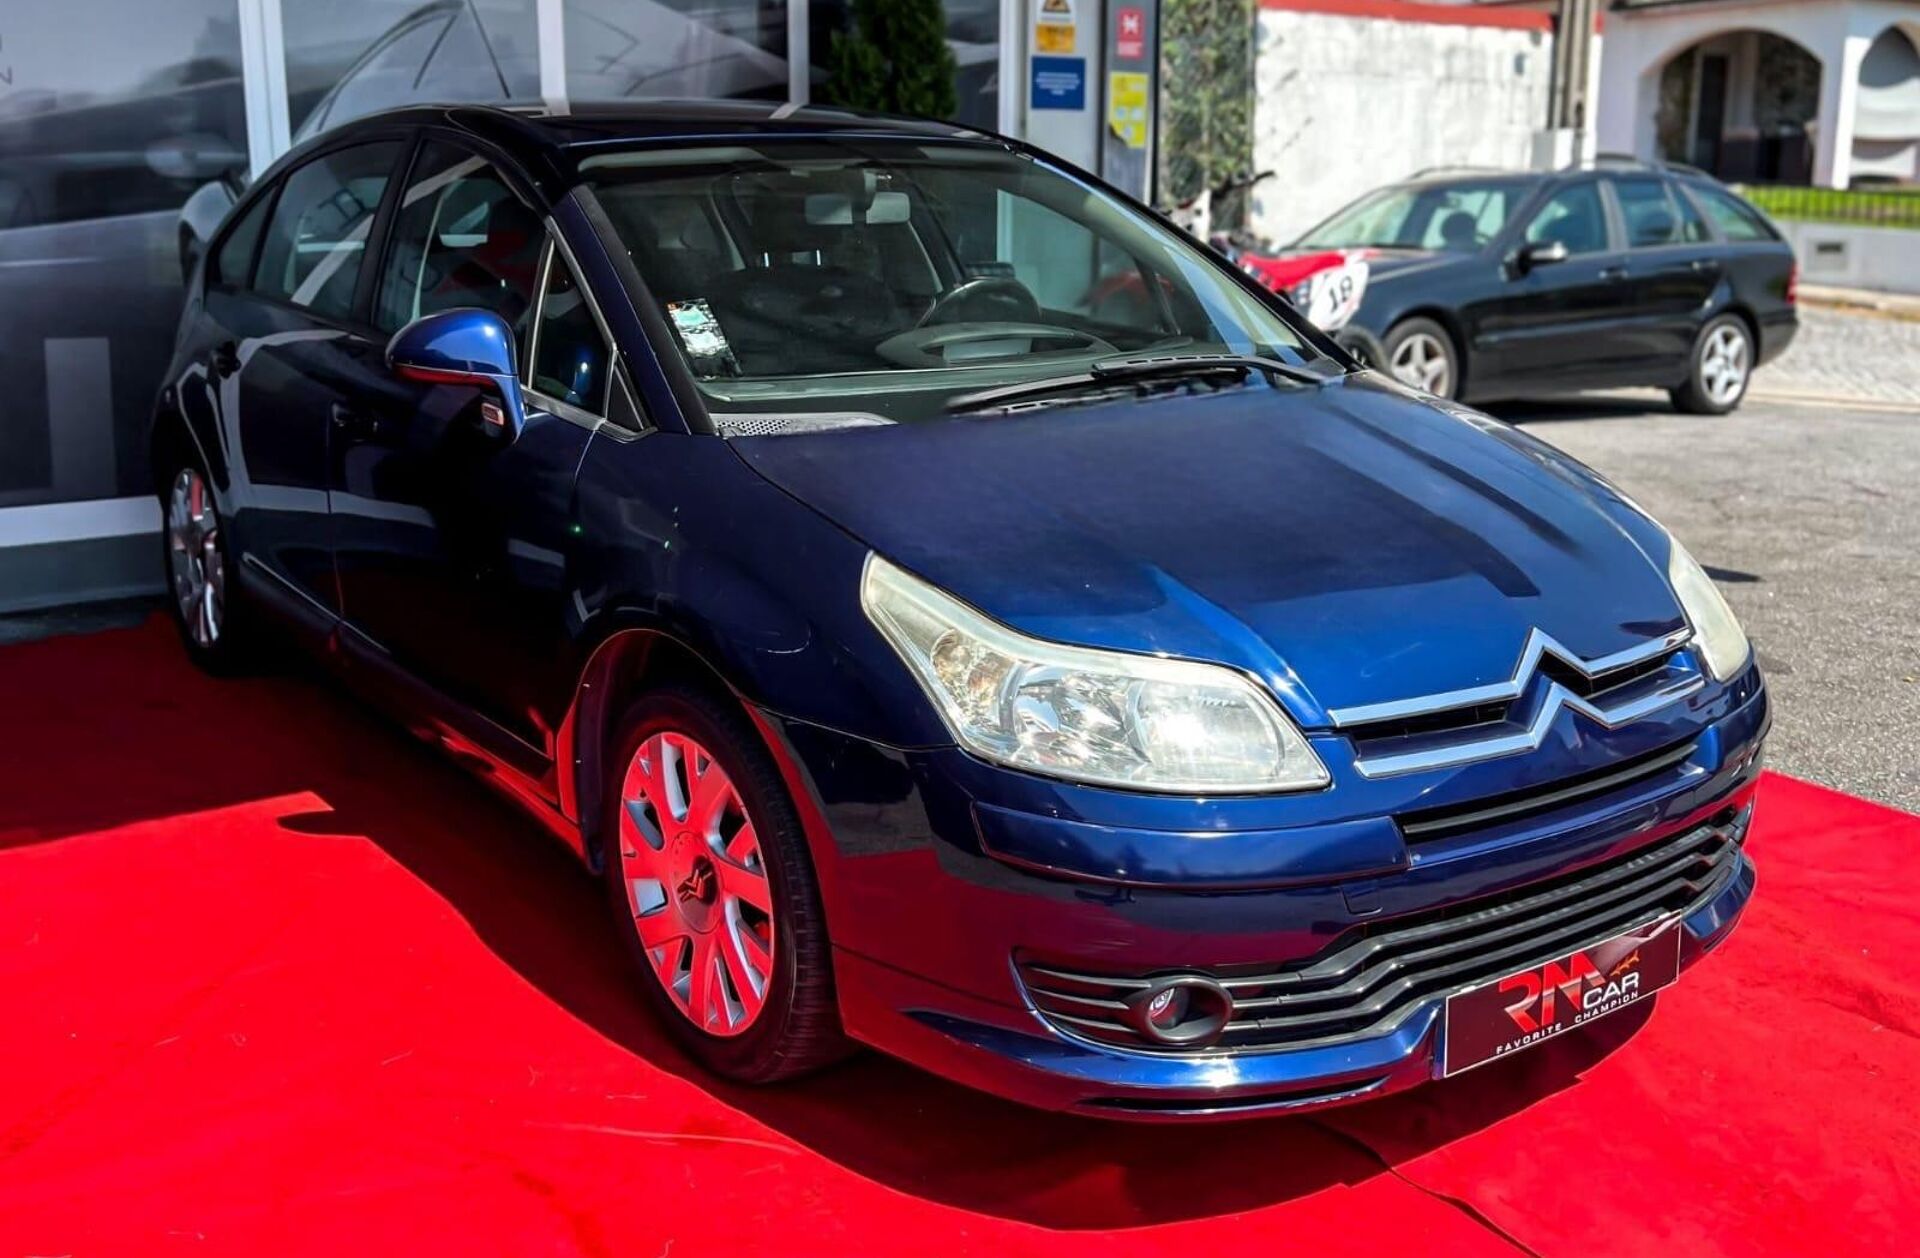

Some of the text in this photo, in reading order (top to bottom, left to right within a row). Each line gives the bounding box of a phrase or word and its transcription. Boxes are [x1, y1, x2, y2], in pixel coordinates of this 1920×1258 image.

[1496, 990, 1639, 1055] FAVORITE CHAMPION
[1499, 951, 1640, 1033] RM CAR
